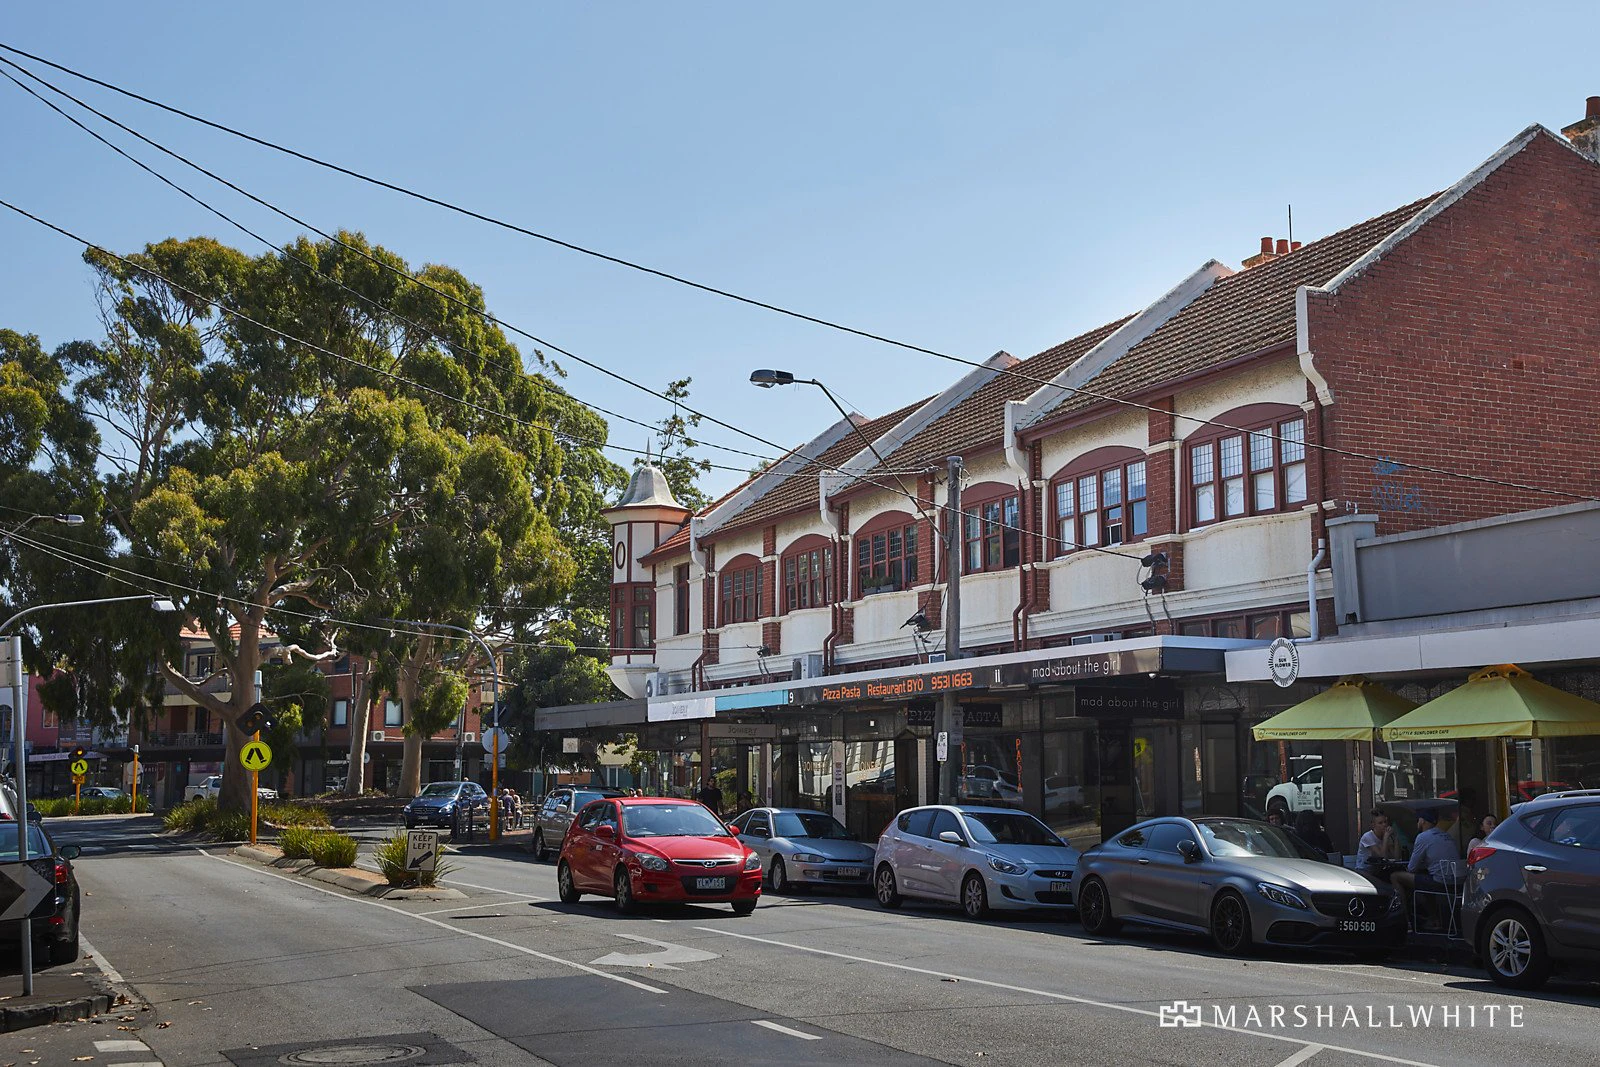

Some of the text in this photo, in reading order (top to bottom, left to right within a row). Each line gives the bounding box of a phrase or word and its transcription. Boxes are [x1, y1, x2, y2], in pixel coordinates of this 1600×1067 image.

[1032, 654, 1119, 678] mad about the girl
[822, 688, 841, 700] Pizza
[841, 686, 861, 700] Pasta
[867, 680, 907, 697] Restaurant
[906, 678, 924, 693] BYO
[789, 691, 794, 704] 9
[1080, 696, 1180, 711] mad about the girl
[413, 834, 432, 842] KEEP
